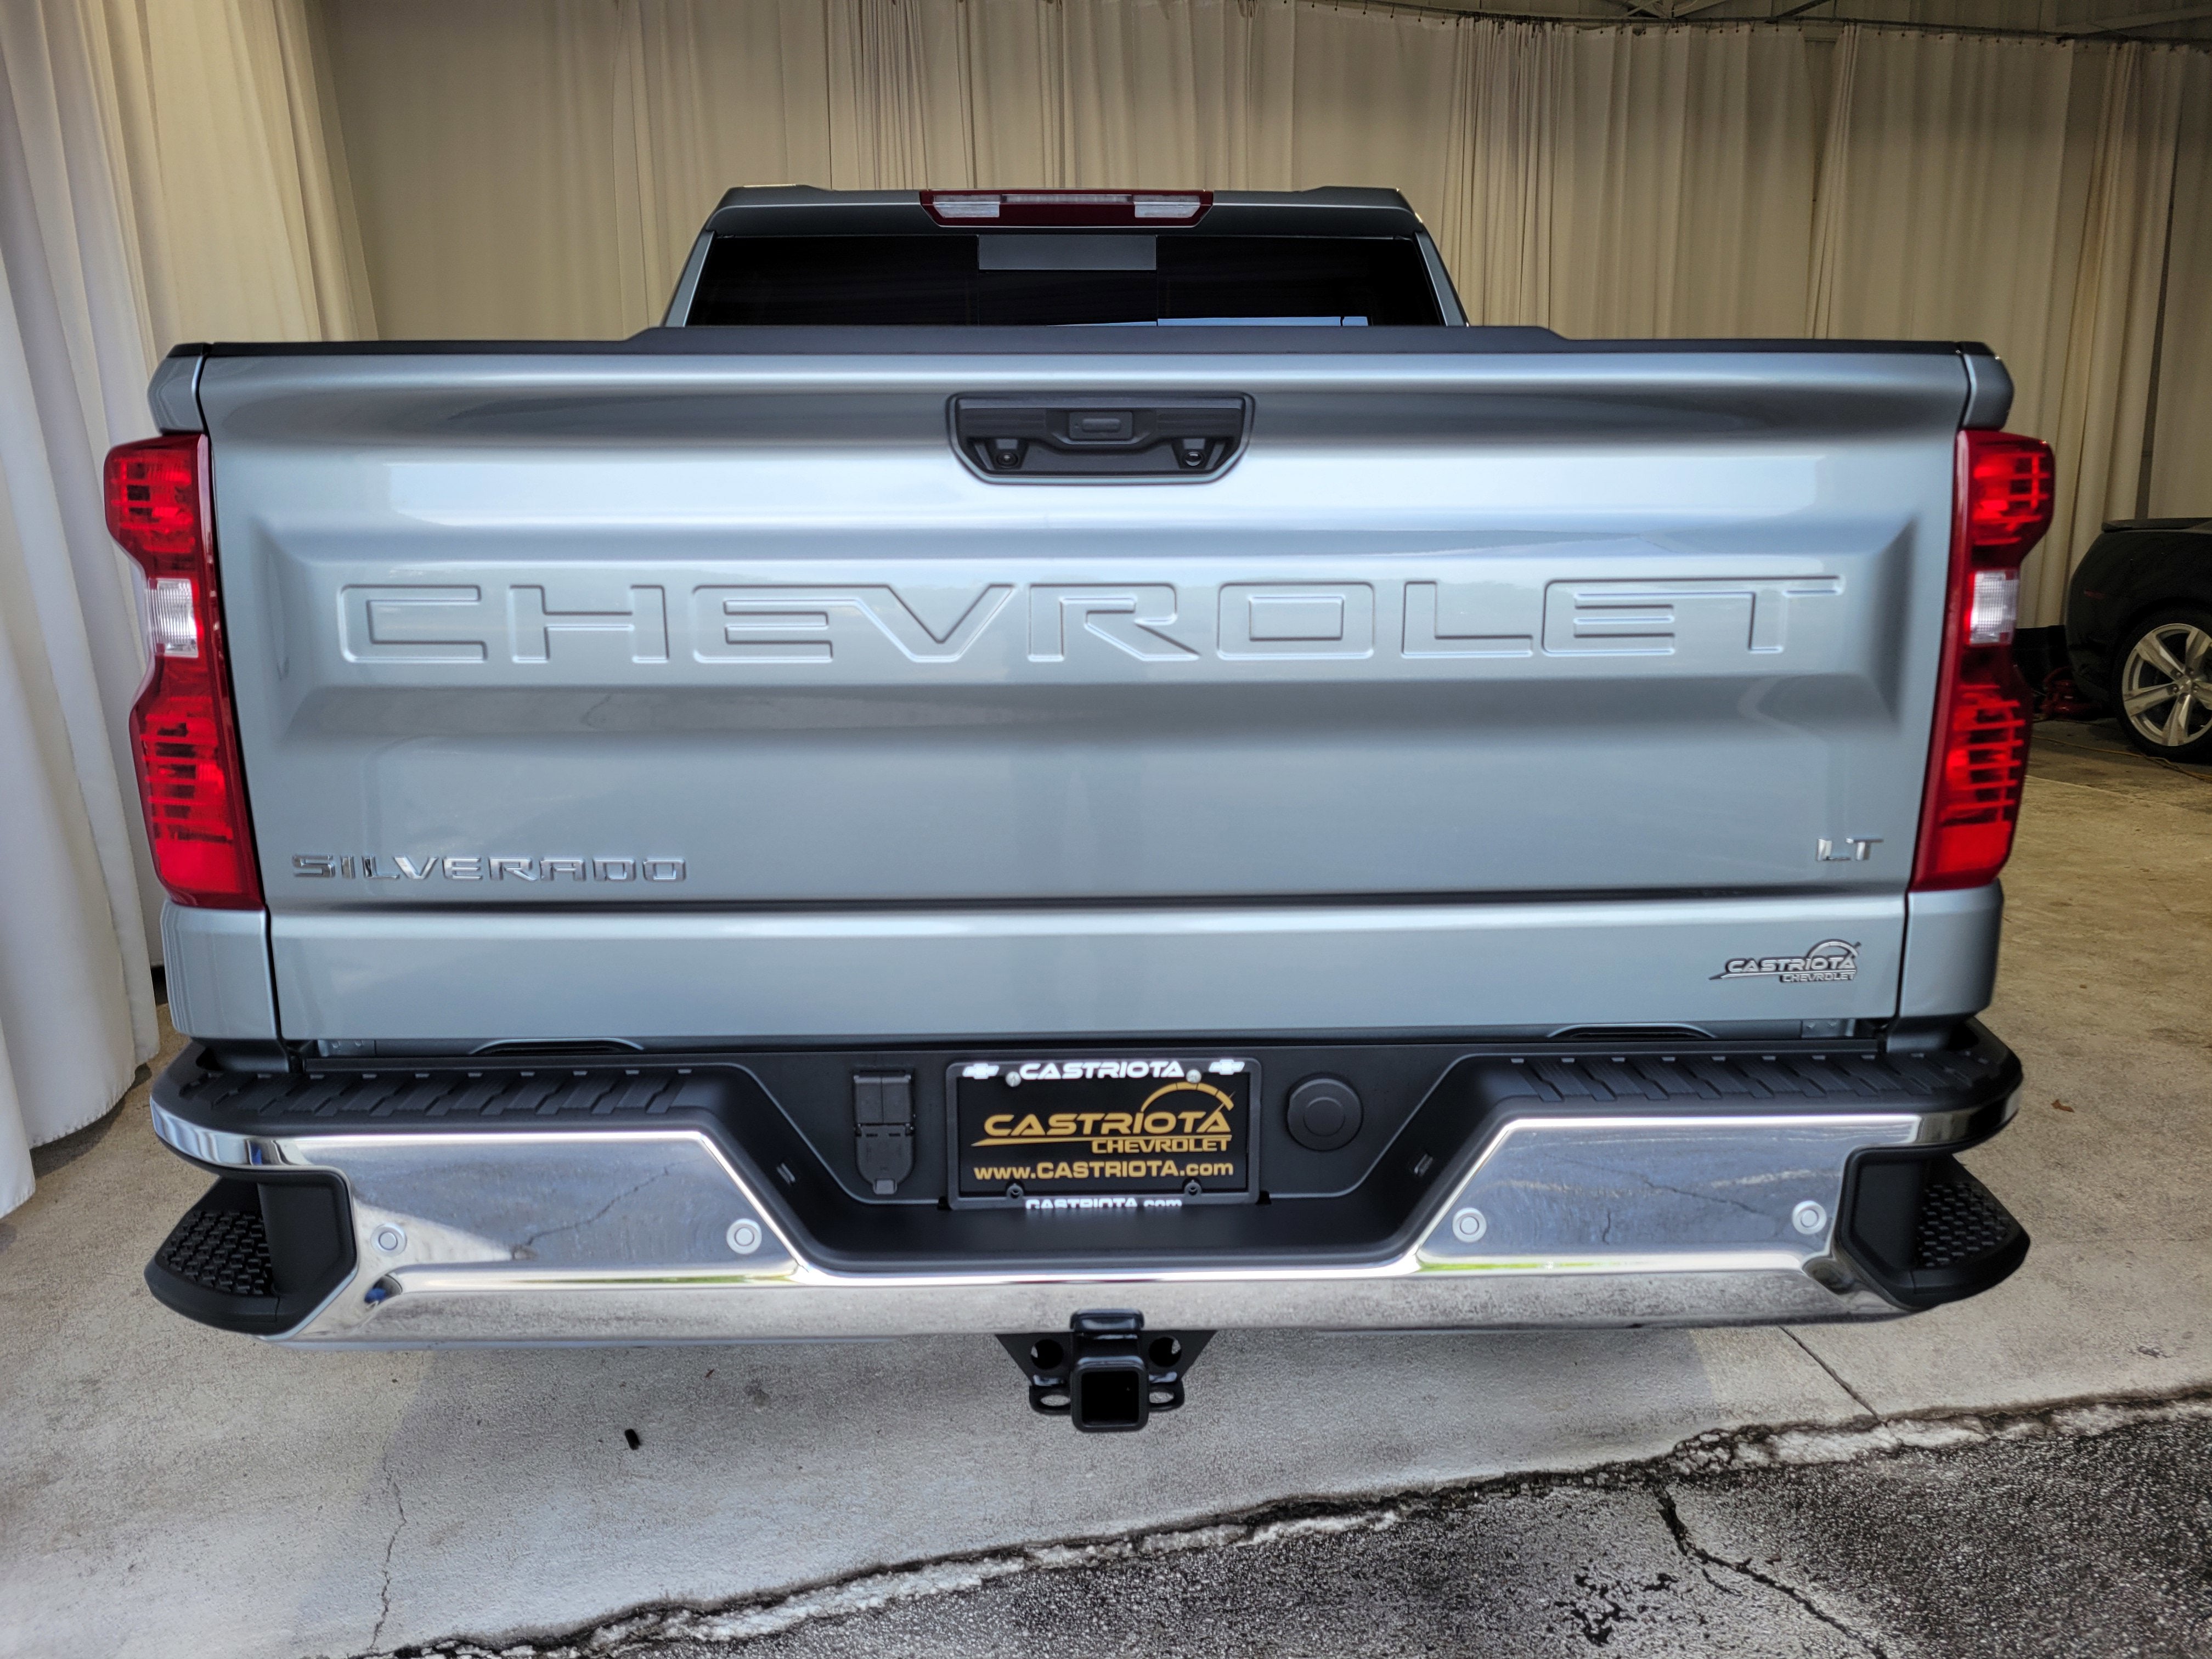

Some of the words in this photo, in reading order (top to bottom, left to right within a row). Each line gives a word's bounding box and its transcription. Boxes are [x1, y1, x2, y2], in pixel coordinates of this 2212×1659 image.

[337, 575, 1844, 662] CHEVROLET
[1816, 838, 1883, 861] LT
[292, 854, 686, 881] SILVERADO
[1726, 956, 1856, 973] CASTRIOTA
[1782, 972, 1855, 983] CHEVROLET
[1019, 1060, 1185, 1080] CASTRIOTA
[984, 1111, 1231, 1136] CASTRIOTA
[1091, 1138, 1229, 1154] CHEVROLET
[974, 1160, 1234, 1180] www.CASTRIOTA.com
